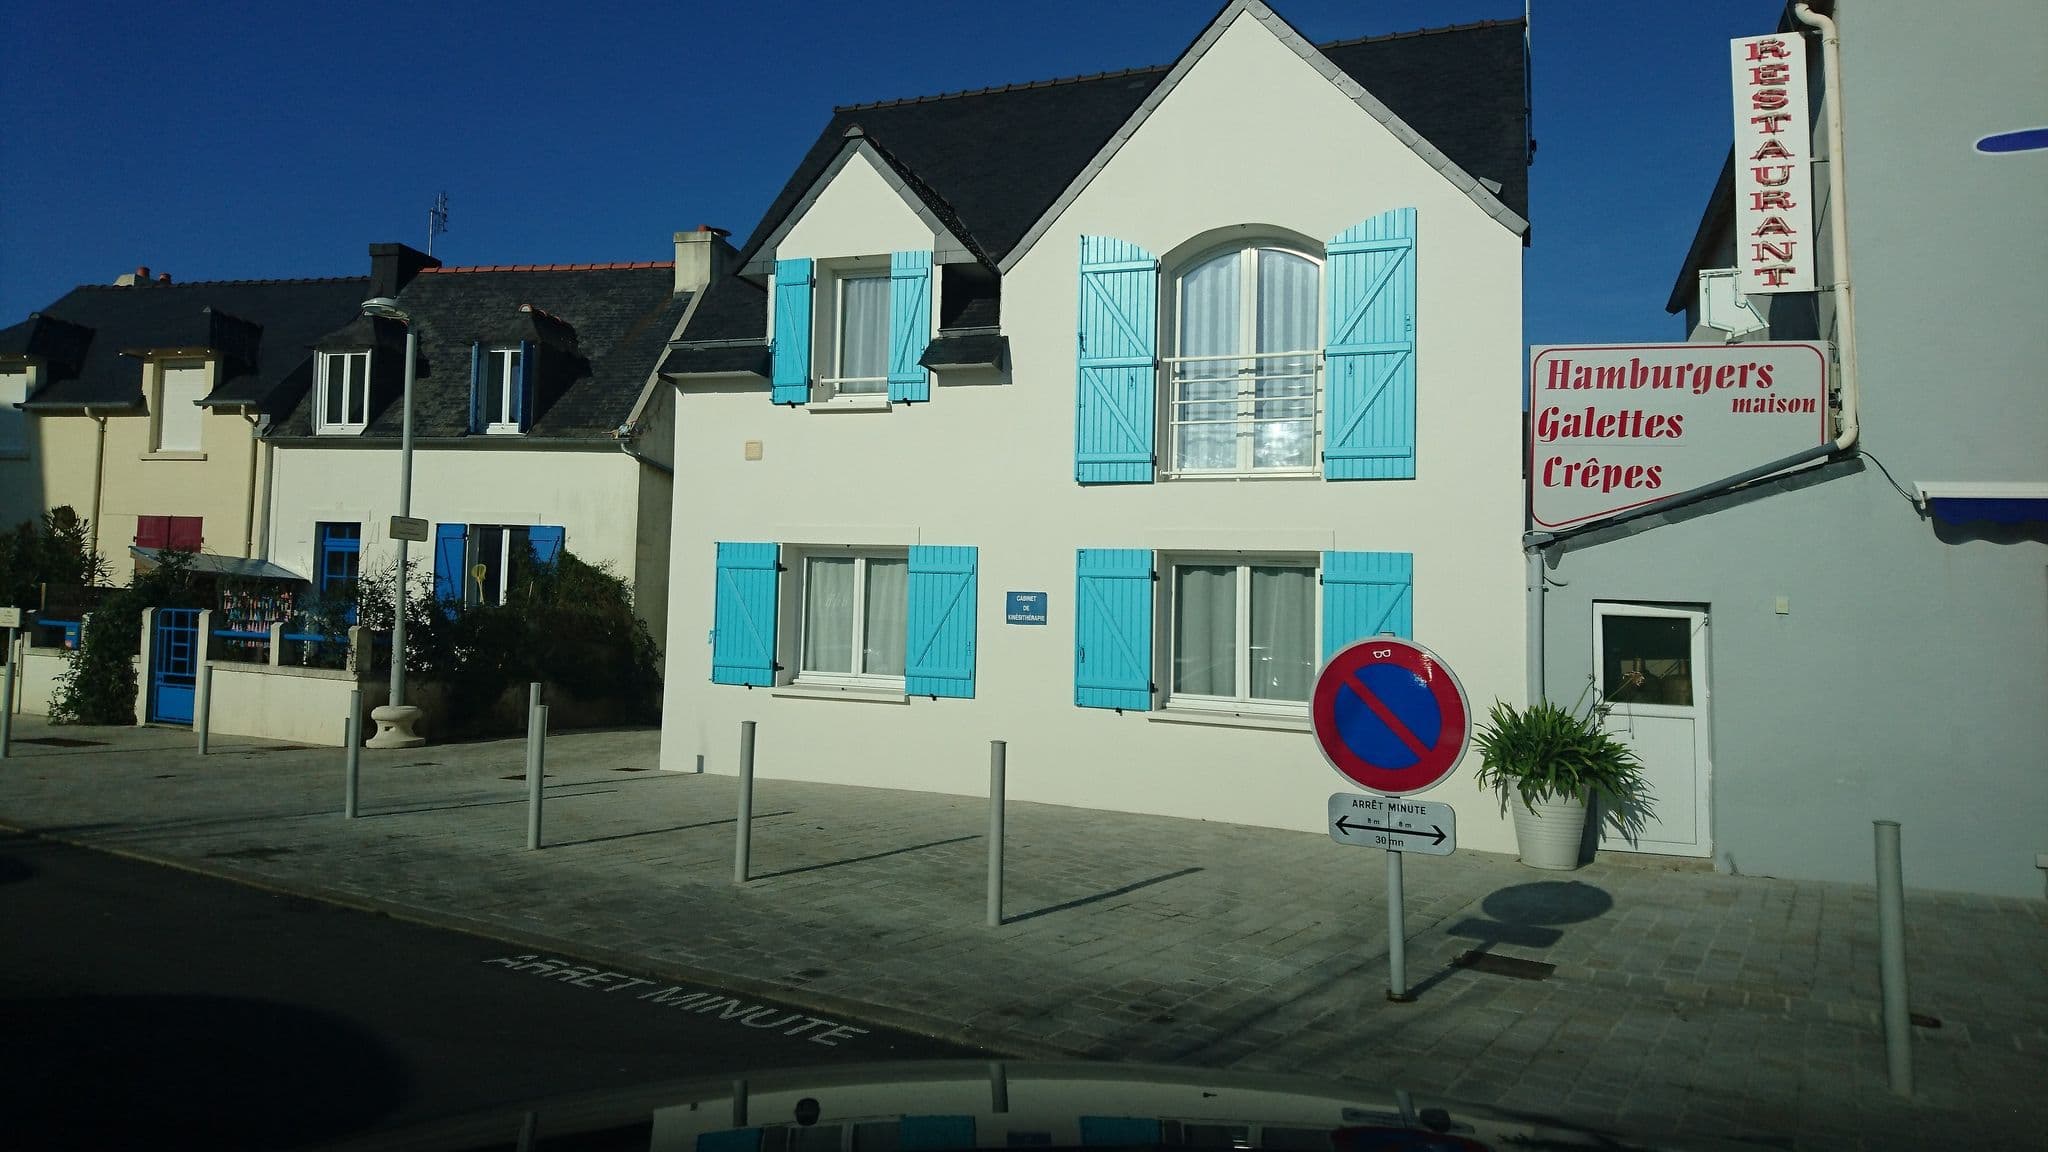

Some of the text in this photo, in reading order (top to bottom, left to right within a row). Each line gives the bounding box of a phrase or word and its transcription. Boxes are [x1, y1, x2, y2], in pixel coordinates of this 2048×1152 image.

[1744, 37, 1797, 288] RESTAURANT
[1545, 357, 1775, 395] Hamburgers
[1731, 393, 1817, 414] maison
[1537, 406, 1684, 443] Galettes
[1543, 456, 1663, 493] Crêpes
[1352, 799, 1426, 815] ARRÊT MINUTE
[1375, 835, 1386, 845] 30
[637, 986, 870, 1047] MINUTE
